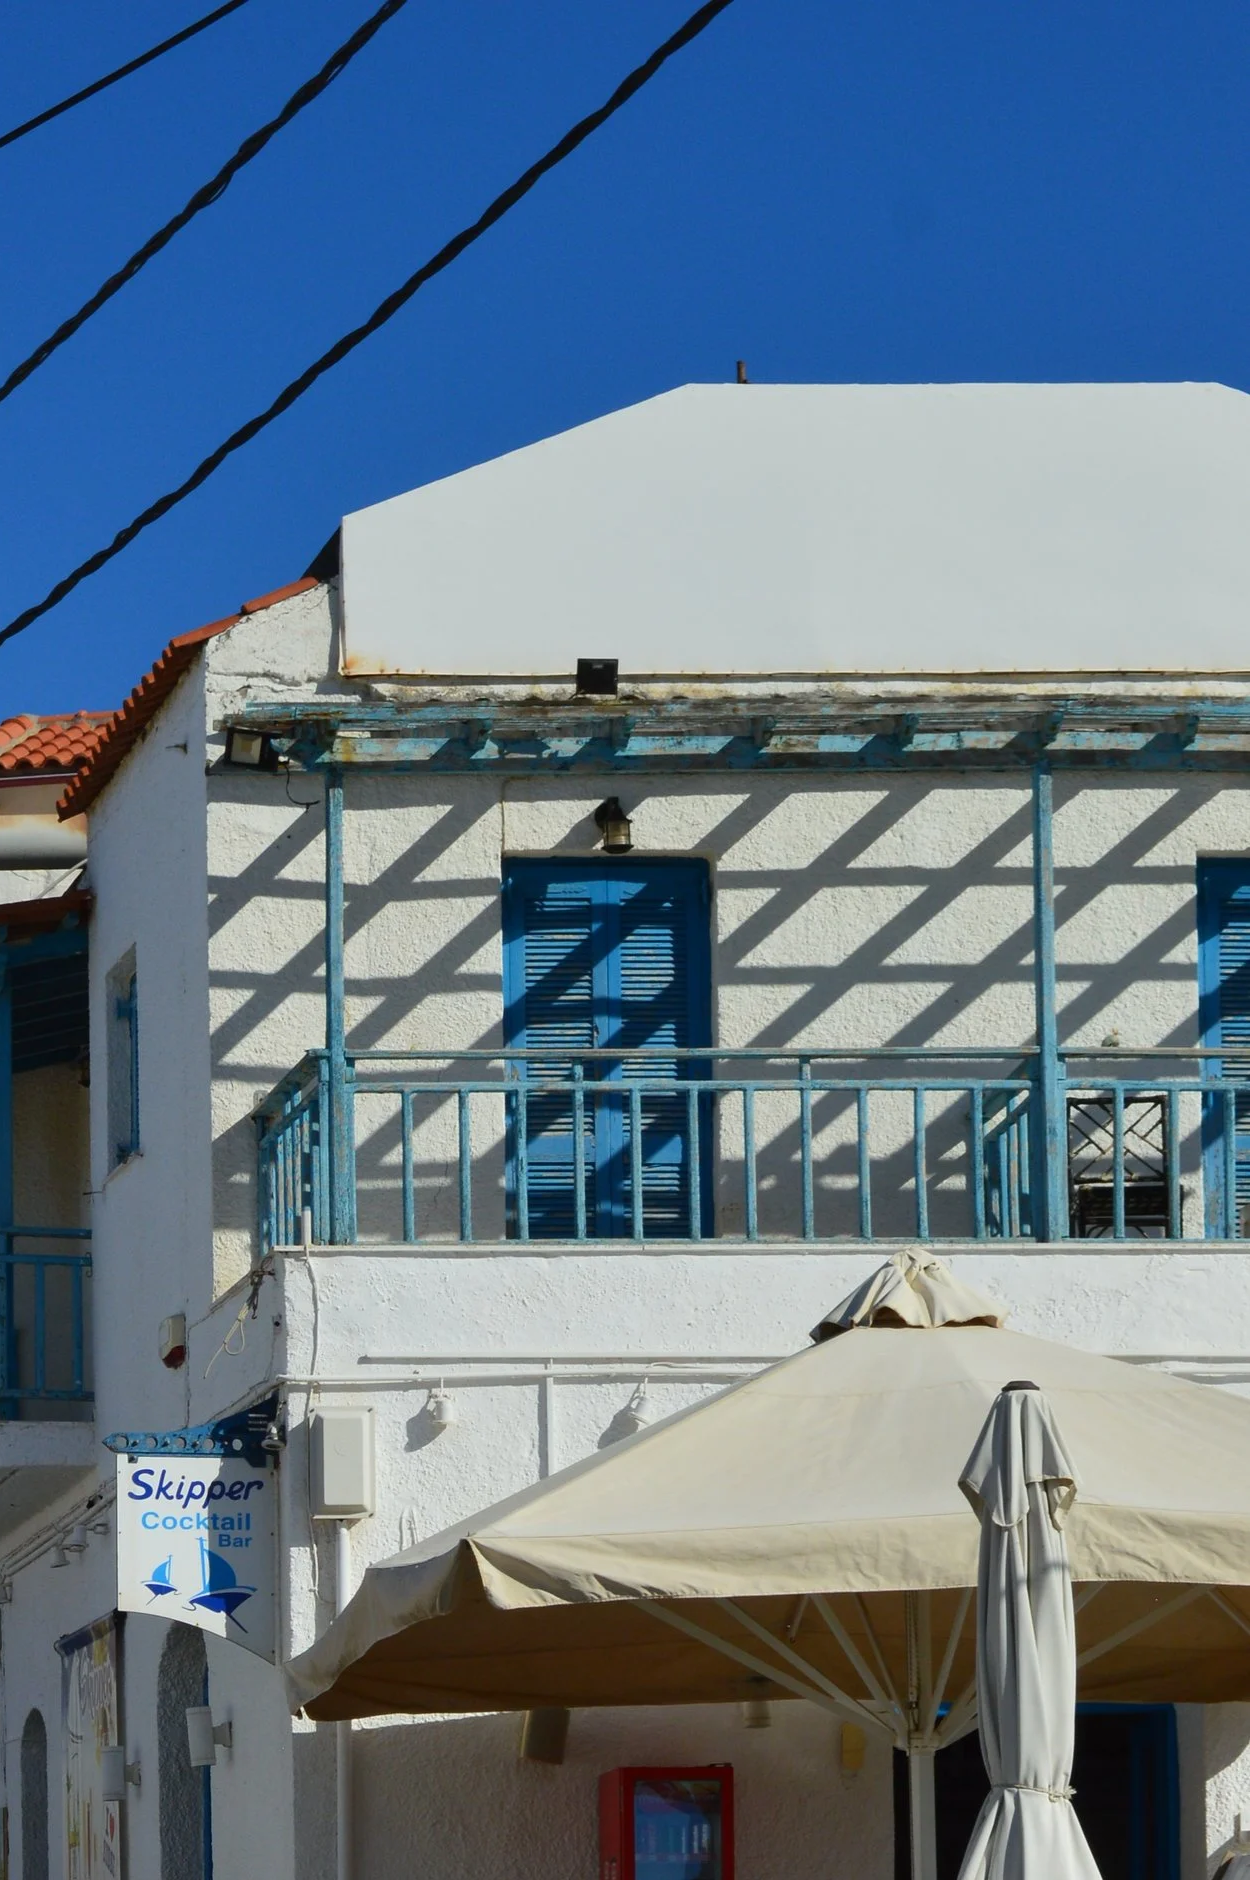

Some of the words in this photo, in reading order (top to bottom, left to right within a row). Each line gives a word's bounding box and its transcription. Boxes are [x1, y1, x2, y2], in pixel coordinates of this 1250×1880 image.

[127, 1468, 264, 1509] Skipper
[141, 1511, 251, 1531] Cocktail
[218, 1533, 253, 1548] Bar
